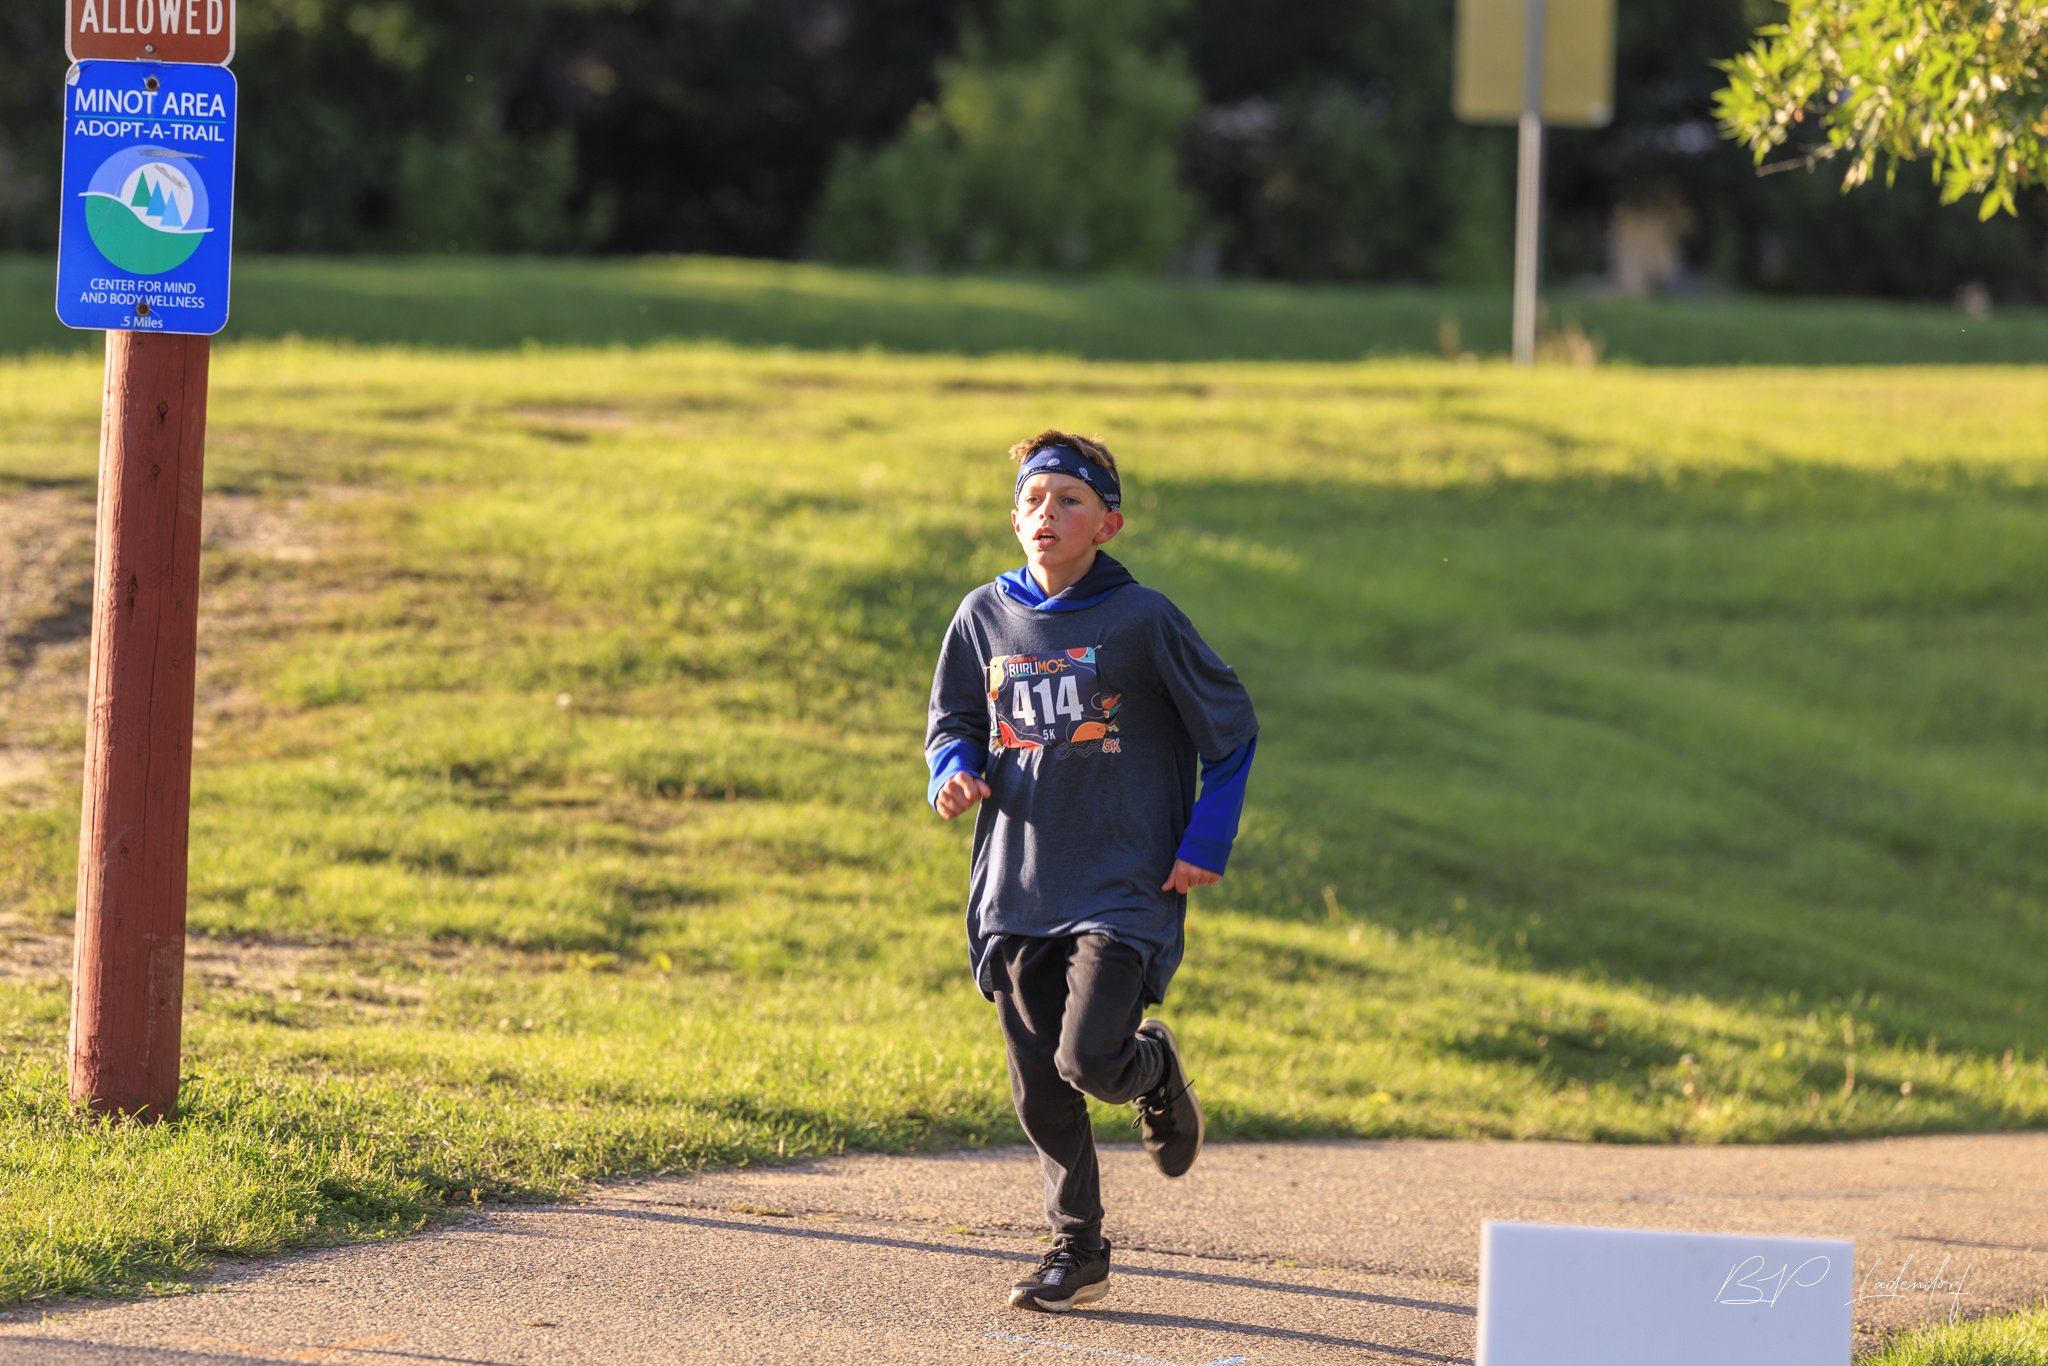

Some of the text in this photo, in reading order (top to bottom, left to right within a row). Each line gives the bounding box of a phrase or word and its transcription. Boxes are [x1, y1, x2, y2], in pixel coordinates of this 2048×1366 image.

[79, 0, 223, 35] ALLOWED
[75, 88, 227, 118] MINOT AREA
[74, 120, 225, 142] ADOPT-A-TRAIL
[90, 278, 196, 294] CENTER FOR MIND
[80, 291, 205, 309] AND BODY WELLNESS
[120, 316, 163, 328] .5 Miles
[1012, 675, 1084, 726] 414
[1043, 729, 1056, 741] 5K
[1102, 738, 1122, 753] 5K
